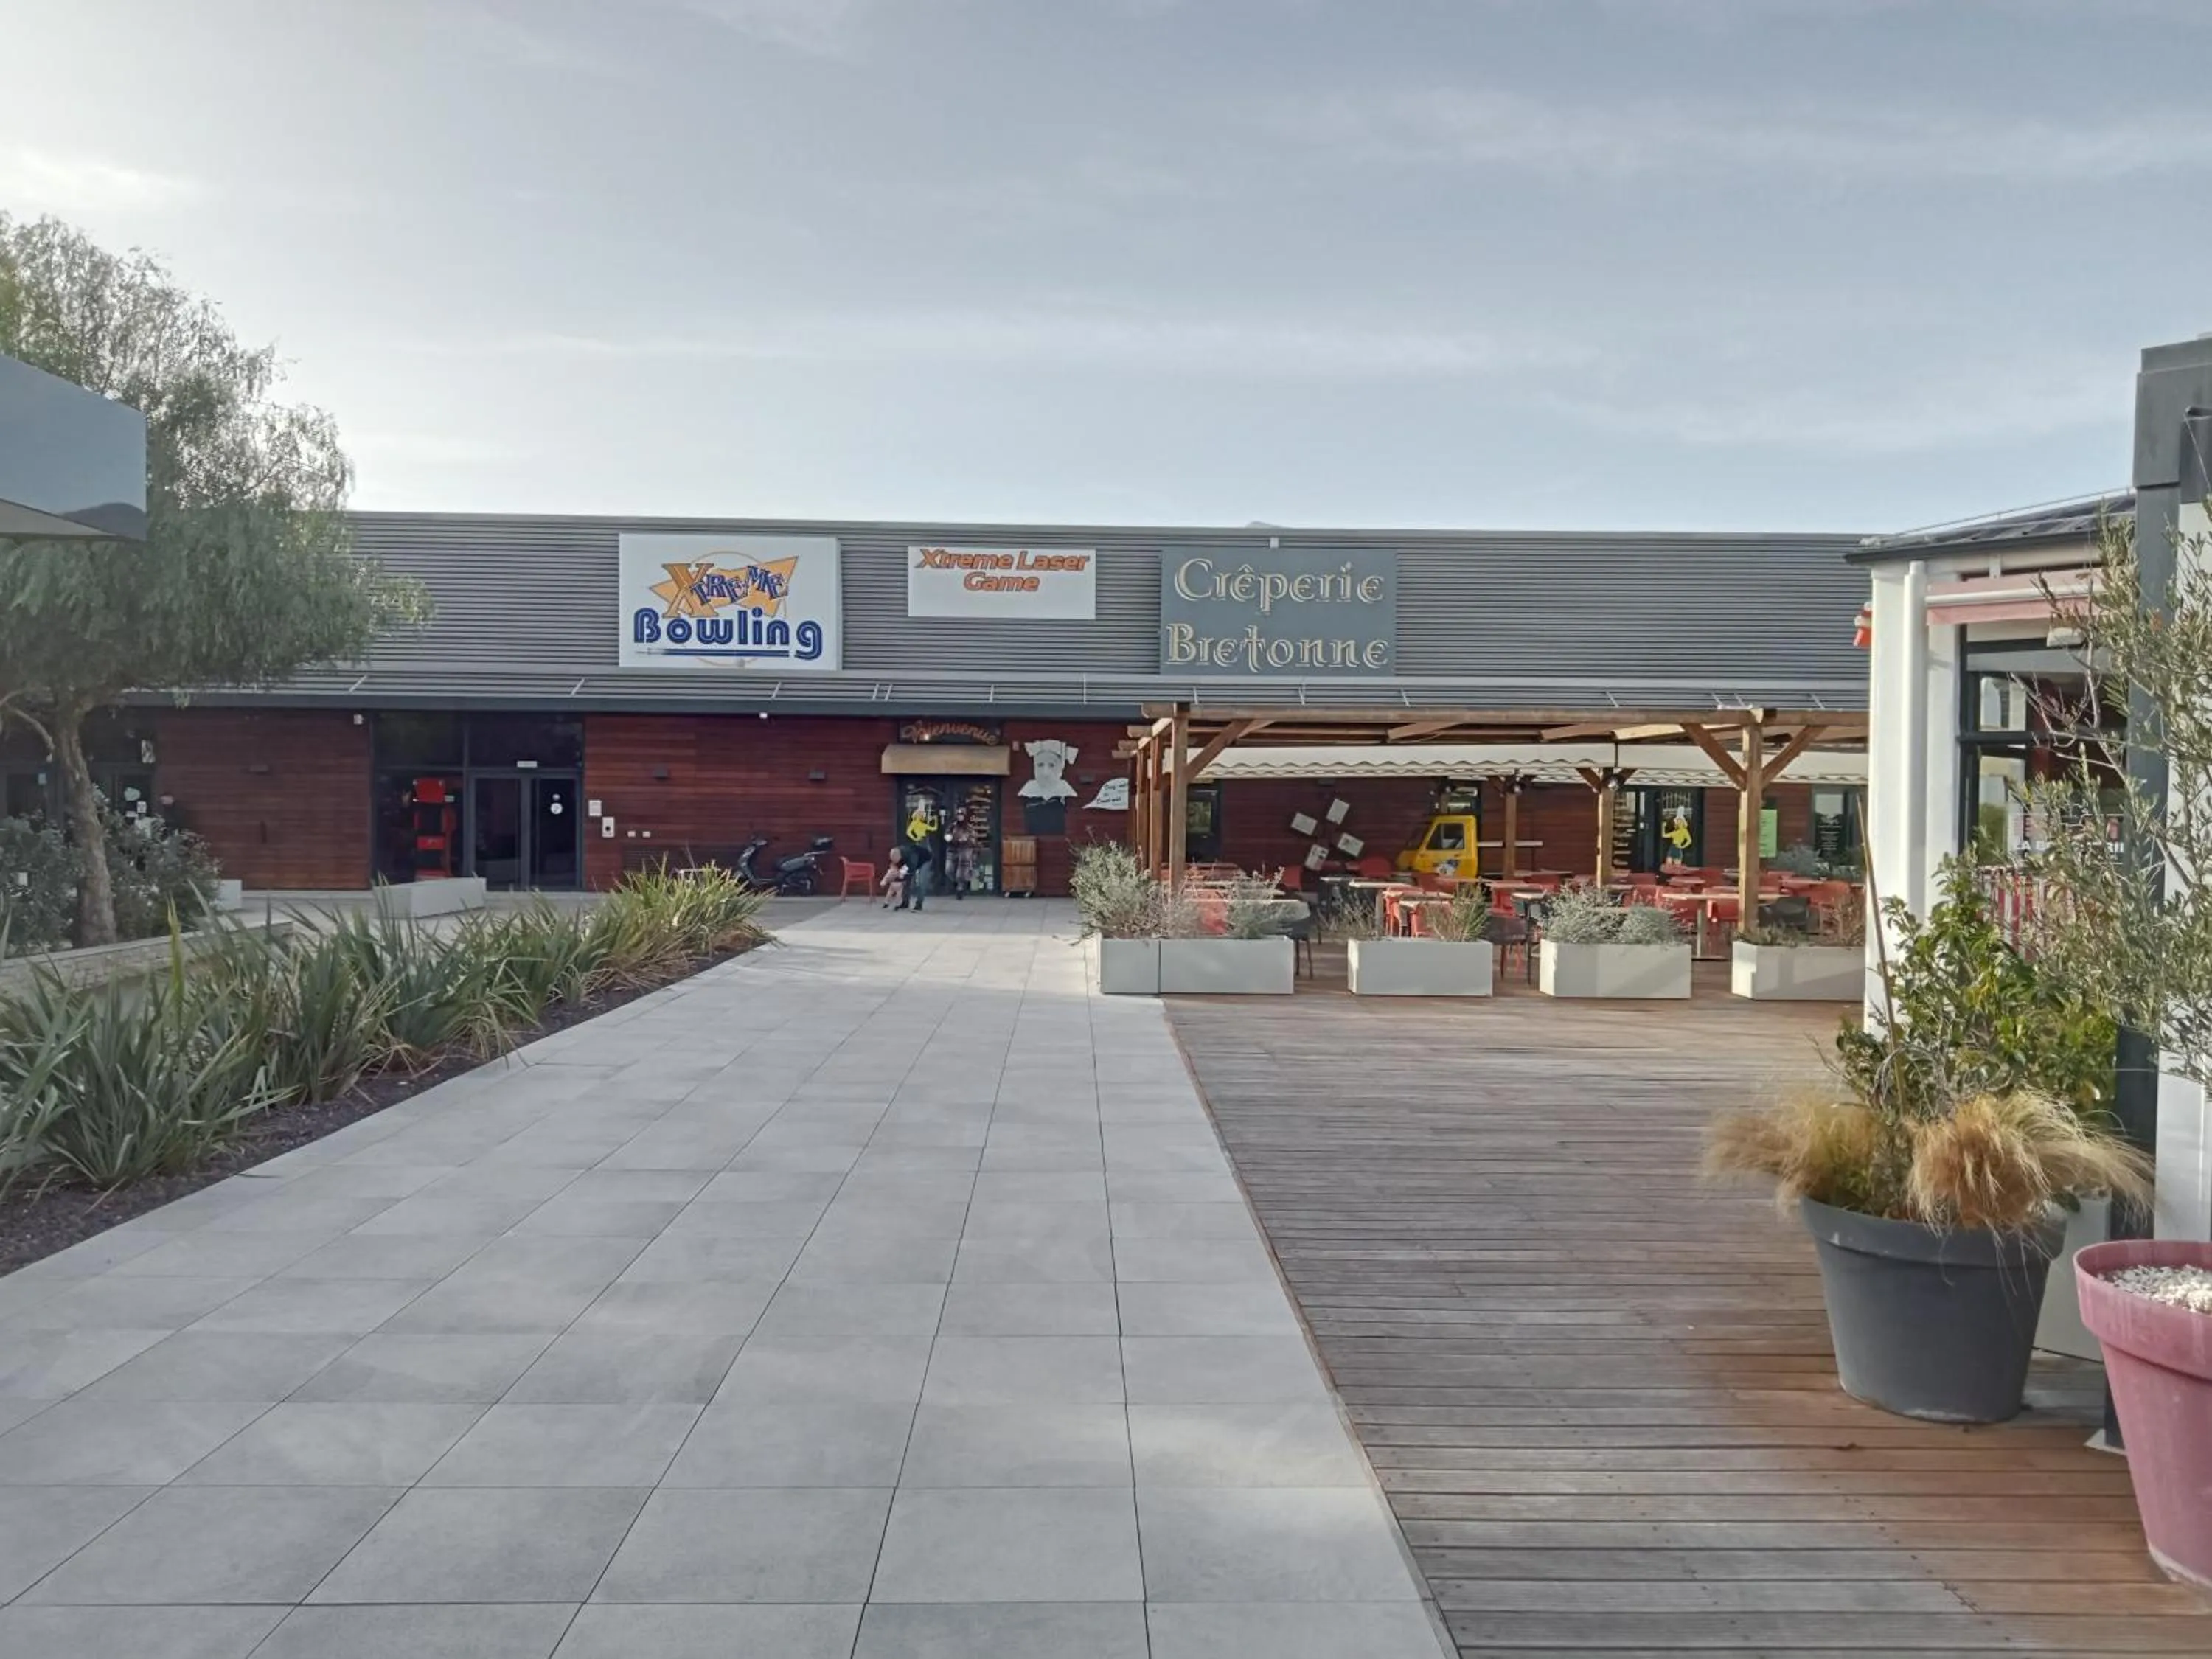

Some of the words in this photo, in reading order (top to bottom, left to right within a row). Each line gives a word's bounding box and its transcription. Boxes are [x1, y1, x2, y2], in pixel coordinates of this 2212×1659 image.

[914, 549, 1013, 570] Xtreme
[1015, 550, 1090, 571] Laser
[964, 571, 1040, 592] Game
[1175, 557, 1385, 615] Crêperie
[633, 607, 823, 660] Bowling
[1166, 623, 1389, 673] Bretonne
